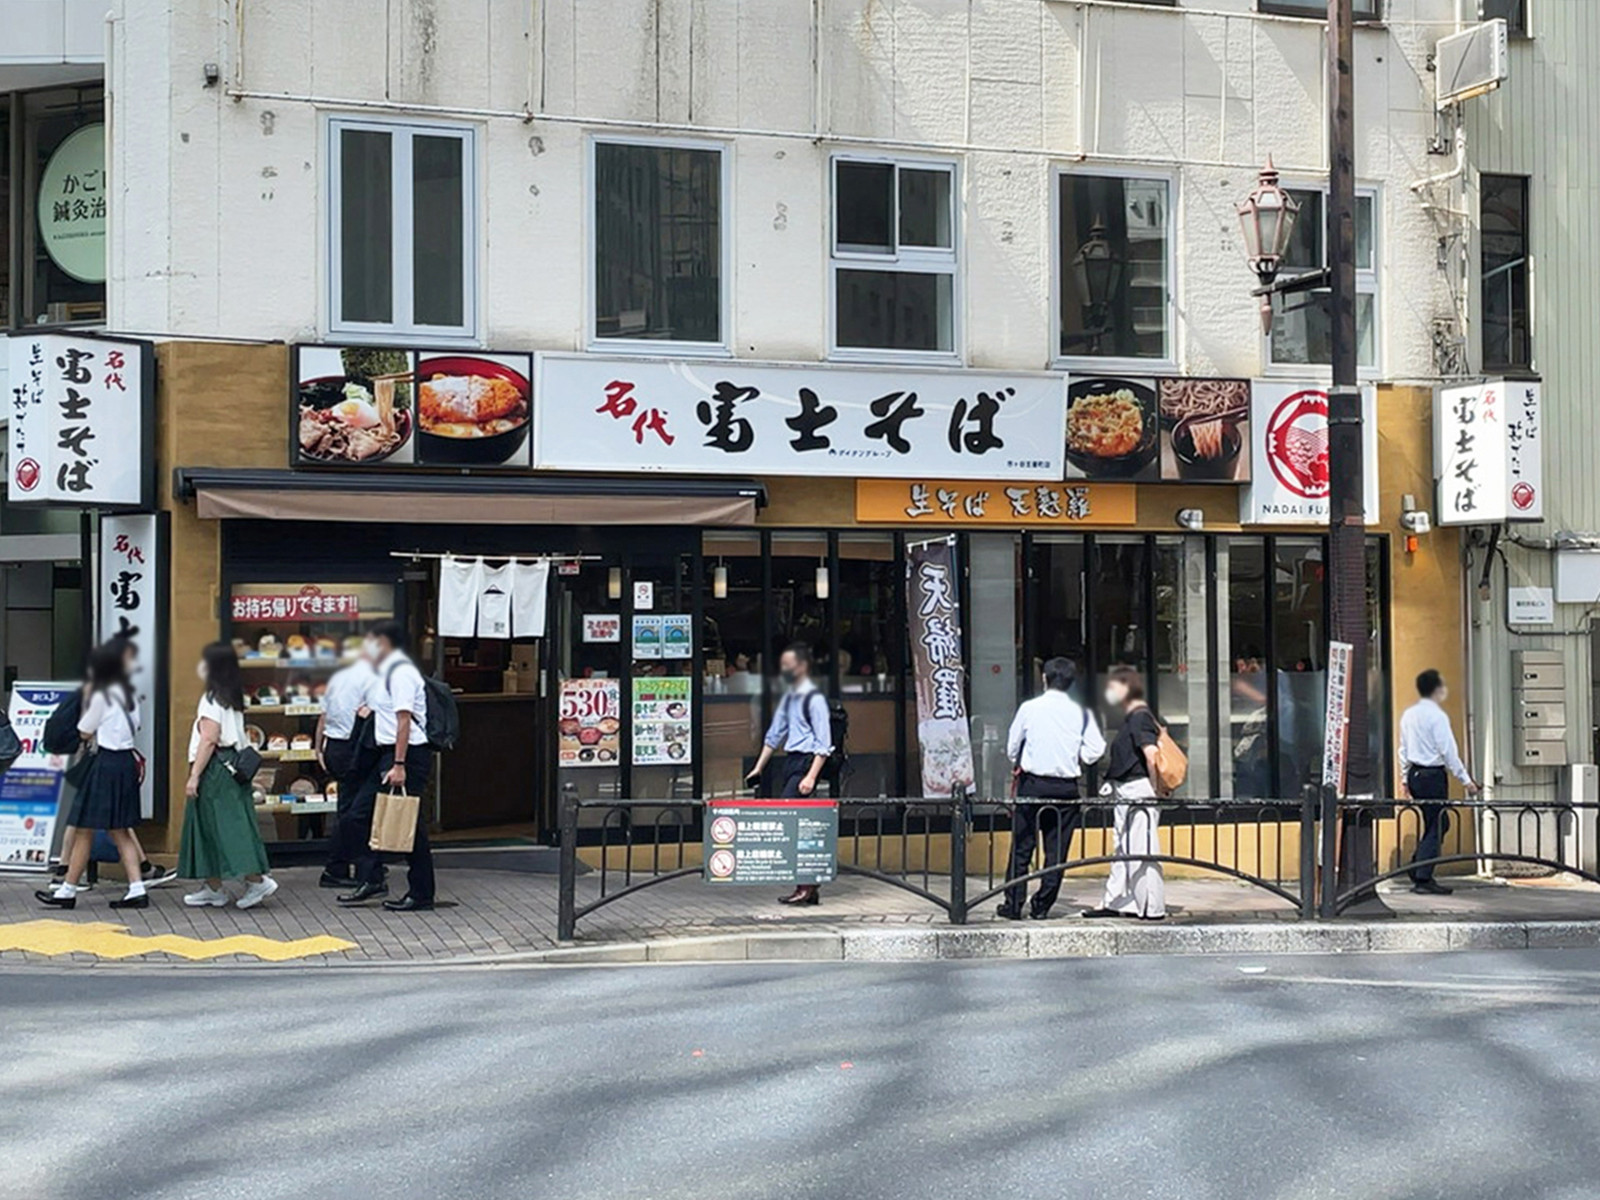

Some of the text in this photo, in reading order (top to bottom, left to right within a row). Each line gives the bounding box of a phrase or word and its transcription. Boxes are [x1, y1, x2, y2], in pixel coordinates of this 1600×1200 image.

[104, 350, 126, 391] 名代
[56, 348, 99, 492] 富士そば
[595, 380, 1016, 455] 名代 富士そば
[1482, 390, 1497, 423] 名代
[1453, 396, 1481, 513] 富士そば
[905, 483, 989, 518] 生そば
[1262, 504, 1303, 514] NADAI
[112, 534, 145, 565] 名代
[232, 595, 359, 618] お持ち帰りできます!!
[562, 689, 607, 717] 530
